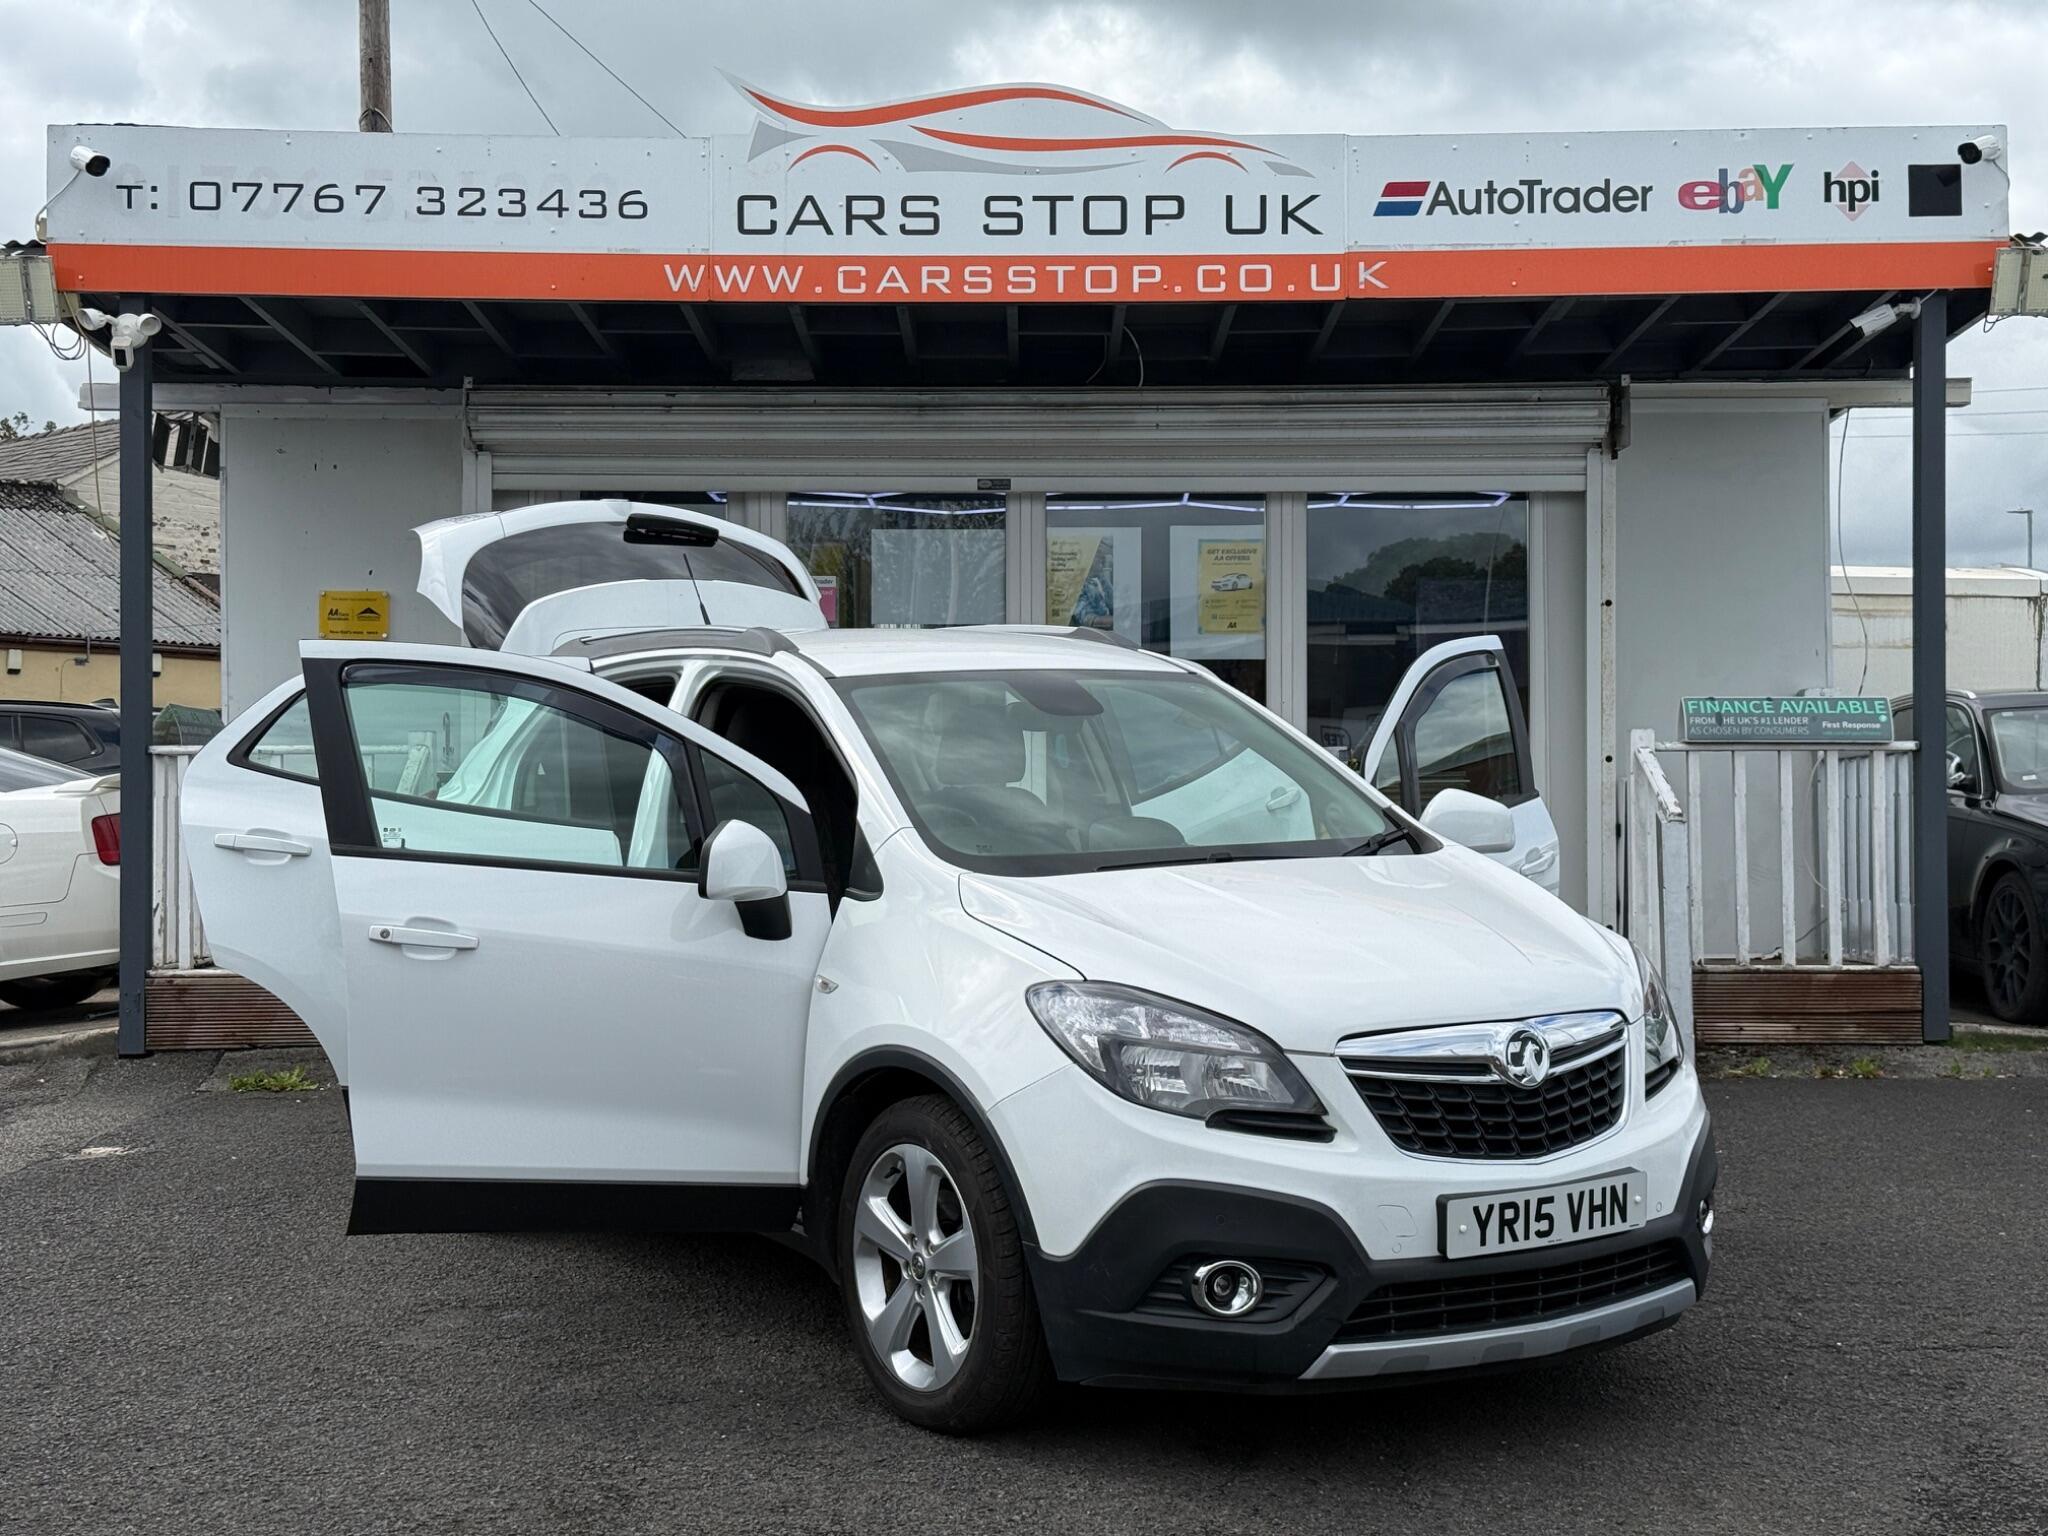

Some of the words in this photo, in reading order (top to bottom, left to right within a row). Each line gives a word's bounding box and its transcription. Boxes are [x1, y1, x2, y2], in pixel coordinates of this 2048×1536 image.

[116, 184, 158, 210] T:
[189, 181, 387, 215] 07767
[416, 186, 648, 220] 323436
[1426, 178, 1654, 216] AutoTrader
[1823, 168, 1880, 205] hpi
[737, 194, 941, 236] CARS
[982, 194, 1186, 236] STOP
[1225, 194, 1323, 236] UK
[663, 260, 1388, 294] WWW.CARSSTOP.CO.UK
[1687, 700, 1774, 715] FINANCE
[1780, 700, 1887, 715] AVAILABLE
[1689, 716, 1716, 725] FROM
[1737, 716, 1759, 725] UK'S
[1760, 716, 1771, 725] #1
[1772, 716, 1809, 725] LENDER
[1689, 726, 1702, 735] AS
[1703, 726, 1739, 735] CHOSEN
[1740, 726, 1752, 735] BY
[1753, 726, 1809, 735] CONSUMERS
[1822, 720, 1841, 729] First
[1842, 720, 1881, 731] Response
[1472, 1194, 1556, 1247] YR15
[1567, 1181, 1629, 1234] VHN
